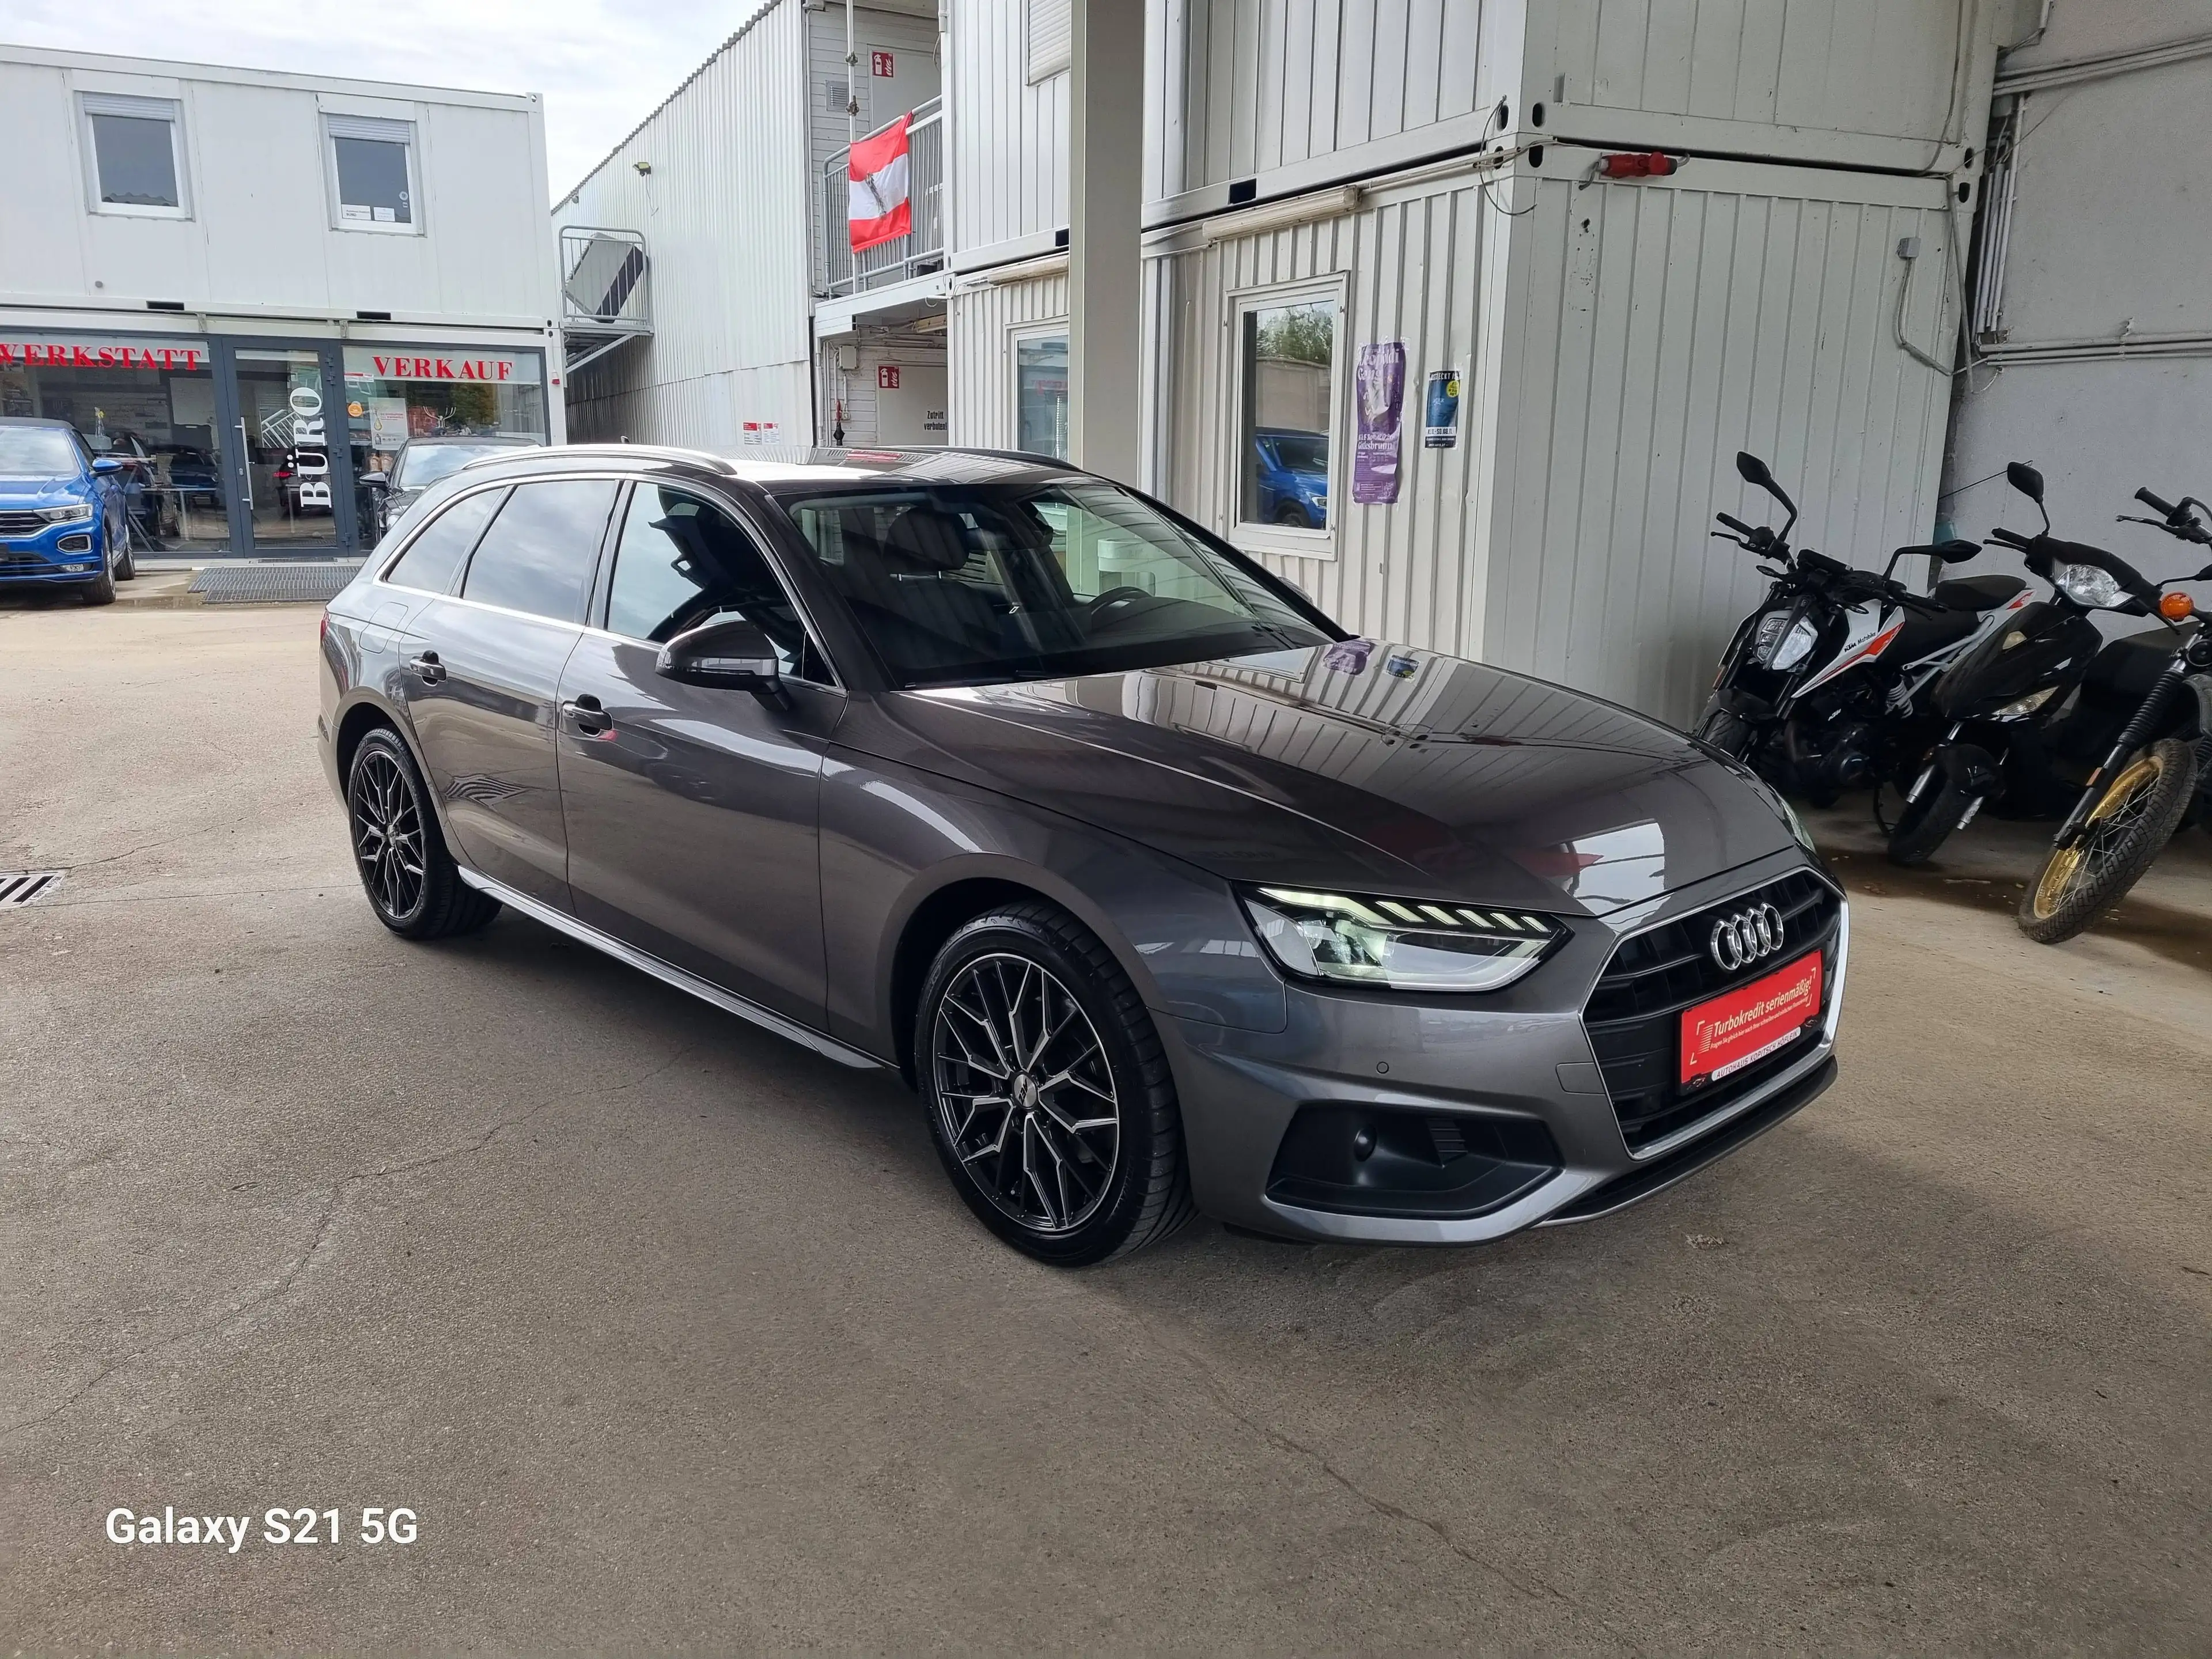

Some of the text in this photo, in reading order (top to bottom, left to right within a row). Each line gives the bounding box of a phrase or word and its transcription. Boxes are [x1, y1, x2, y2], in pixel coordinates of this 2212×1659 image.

[372, 355, 513, 380] VERKAUF
[287, 387, 332, 508] BÜRO
[1844, 643, 1857, 652] KTM
[1714, 975, 1812, 1037] Turbokredit serienmäßig!
[1717, 1058, 1748, 1078] AUTOHAUS
[1750, 1043, 1776, 1062] KOPITSCH
